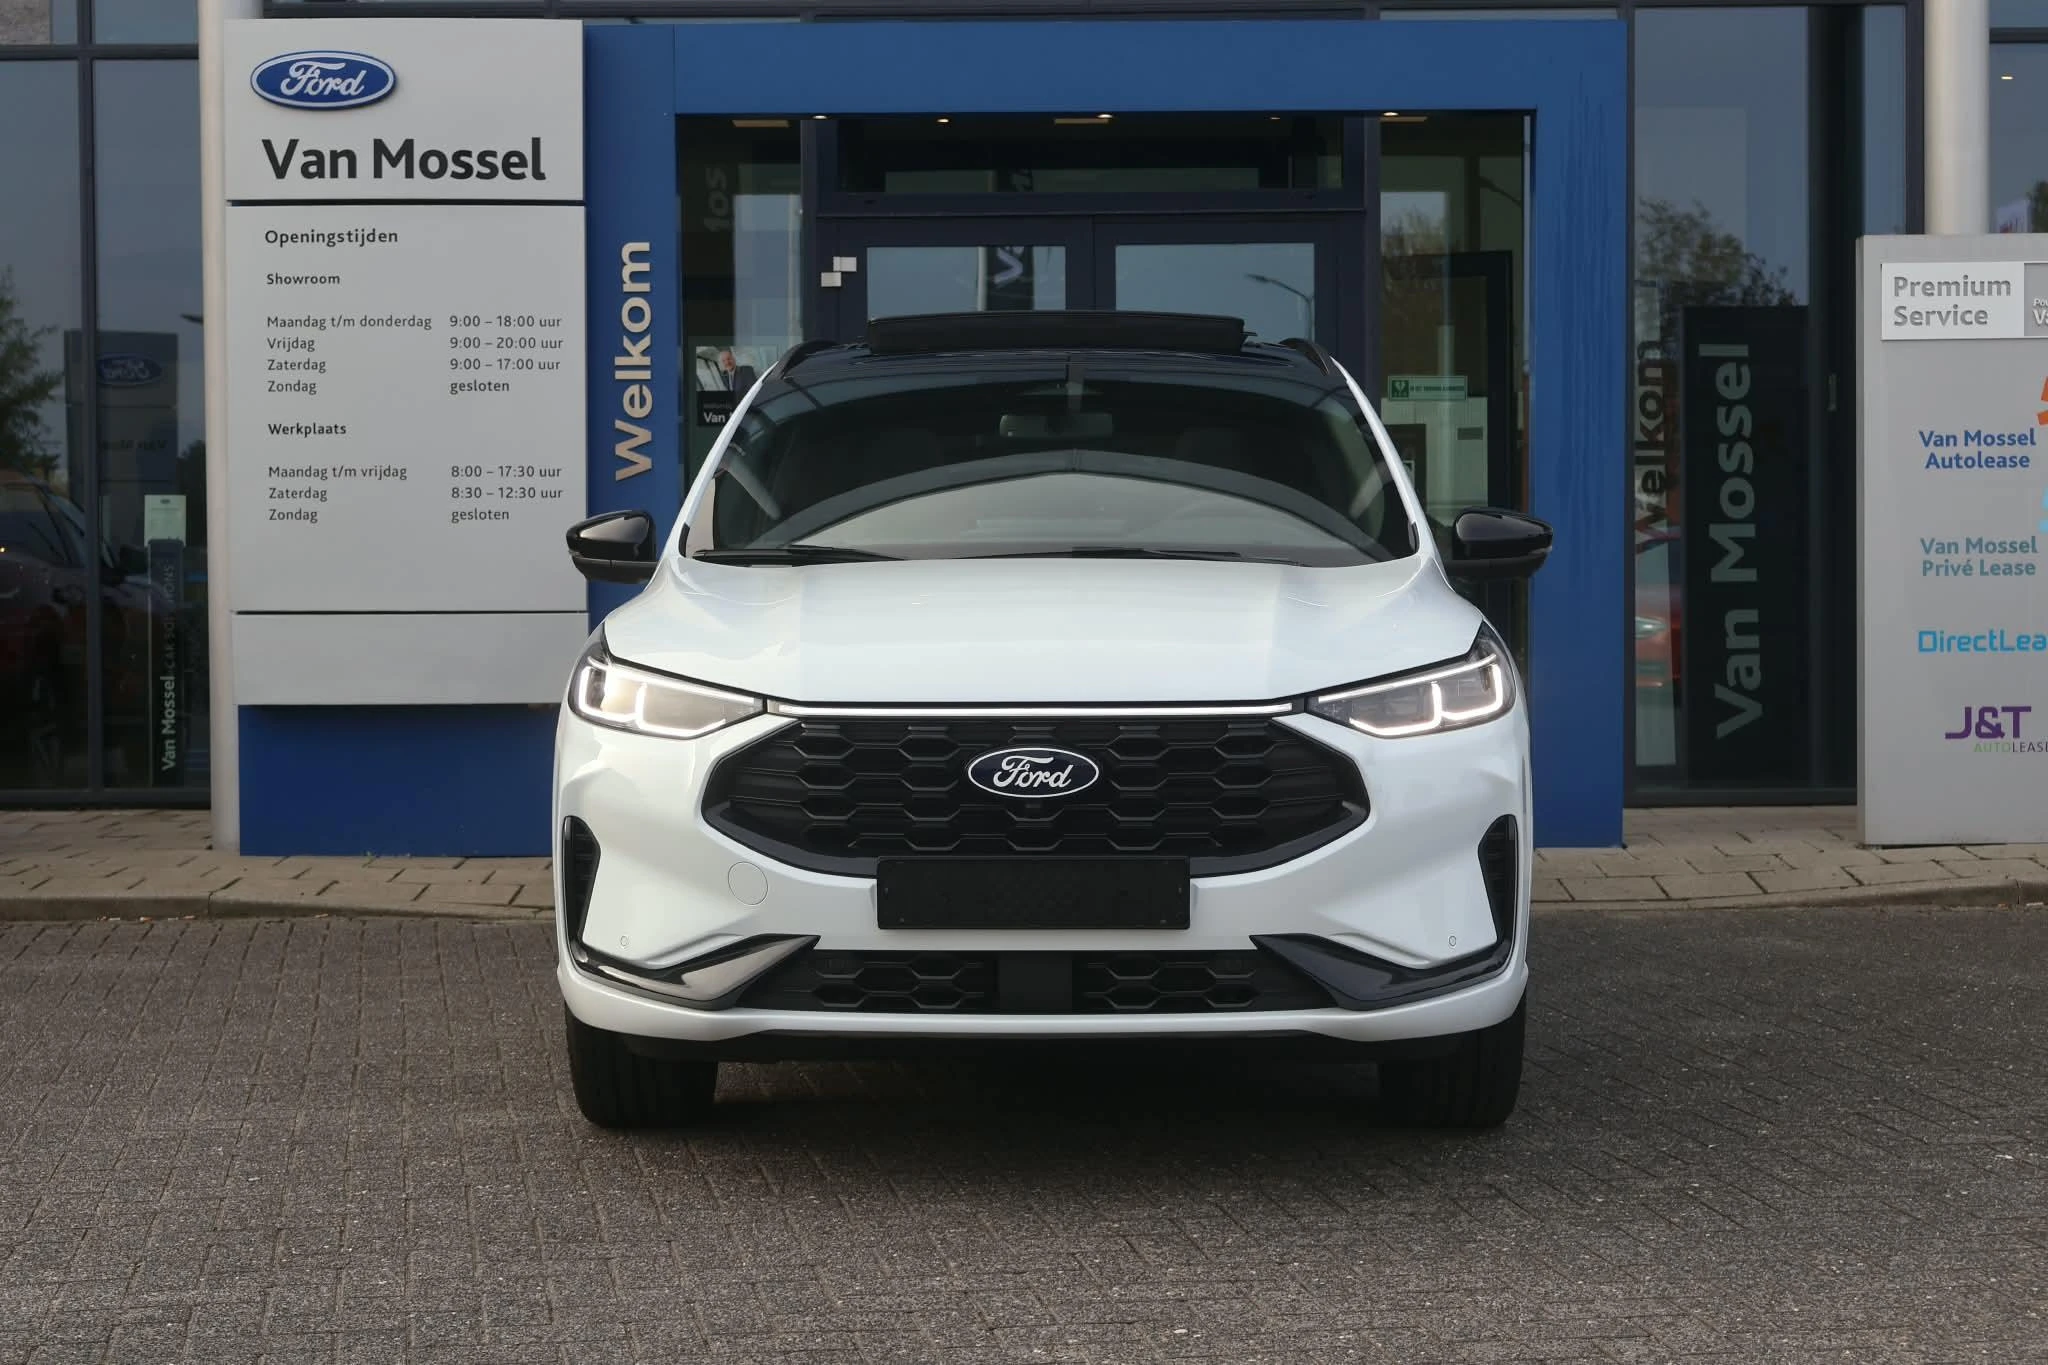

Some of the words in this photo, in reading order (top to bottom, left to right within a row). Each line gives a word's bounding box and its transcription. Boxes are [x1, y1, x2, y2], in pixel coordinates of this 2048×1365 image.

[279, 59, 366, 97] Ford
[261, 138, 357, 180] Van
[373, 136, 547, 181] Mossel
[264, 227, 398, 247] Openingstijden
[266, 272, 341, 285] Showroom
[1893, 274, 2011, 297] Premium
[267, 314, 327, 331] Maandag
[330, 314, 356, 328] t/m
[359, 314, 432, 331] donderdag
[449, 314, 481, 328] 9:00
[496, 315, 535, 328] 18:00
[539, 318, 562, 328] uur
[1893, 303, 1989, 327] Service
[266, 336, 316, 353] Vrijdag
[449, 336, 481, 349] 9:00
[496, 336, 537, 349] 20:00
[540, 339, 564, 349] uur
[267, 357, 327, 374] Zaterdag
[449, 357, 481, 371] 9:00
[496, 358, 534, 371] 17:00
[538, 361, 561, 371] uur
[613, 241, 653, 482] Welkom
[267, 379, 318, 396] Zondag
[449, 379, 510, 396] gesloten
[702, 411, 727, 424] Van
[267, 422, 347, 439] Werkplaats
[1918, 430, 1958, 448] Van
[1963, 427, 2037, 447] Mossel
[1699, 343, 1757, 583] Mossel
[1925, 450, 2031, 469] Autolease
[268, 465, 329, 481] Maandag
[331, 465, 357, 478] t/m
[360, 464, 408, 481] vrijdag
[451, 465, 483, 478] 8:00
[498, 465, 535, 478] 17:30
[539, 468, 562, 478] uur
[268, 486, 328, 503] Zaterdag
[451, 486, 482, 499] 8:30
[498, 486, 536, 499] 12:30
[540, 489, 563, 499] uur
[268, 507, 318, 524] Zondag
[451, 507, 510, 524] gesloten
[1919, 537, 1959, 555] Van
[1965, 535, 2038, 555] Mossel
[1922, 558, 1974, 577] Privé
[1979, 559, 2037, 577] Lease
[1710, 608, 1762, 739] Van
[160, 676, 176, 735] Mossel
[1944, 705, 2033, 740] J&T
[161, 739, 176, 771] Van
[992, 756, 1074, 788] Ford
